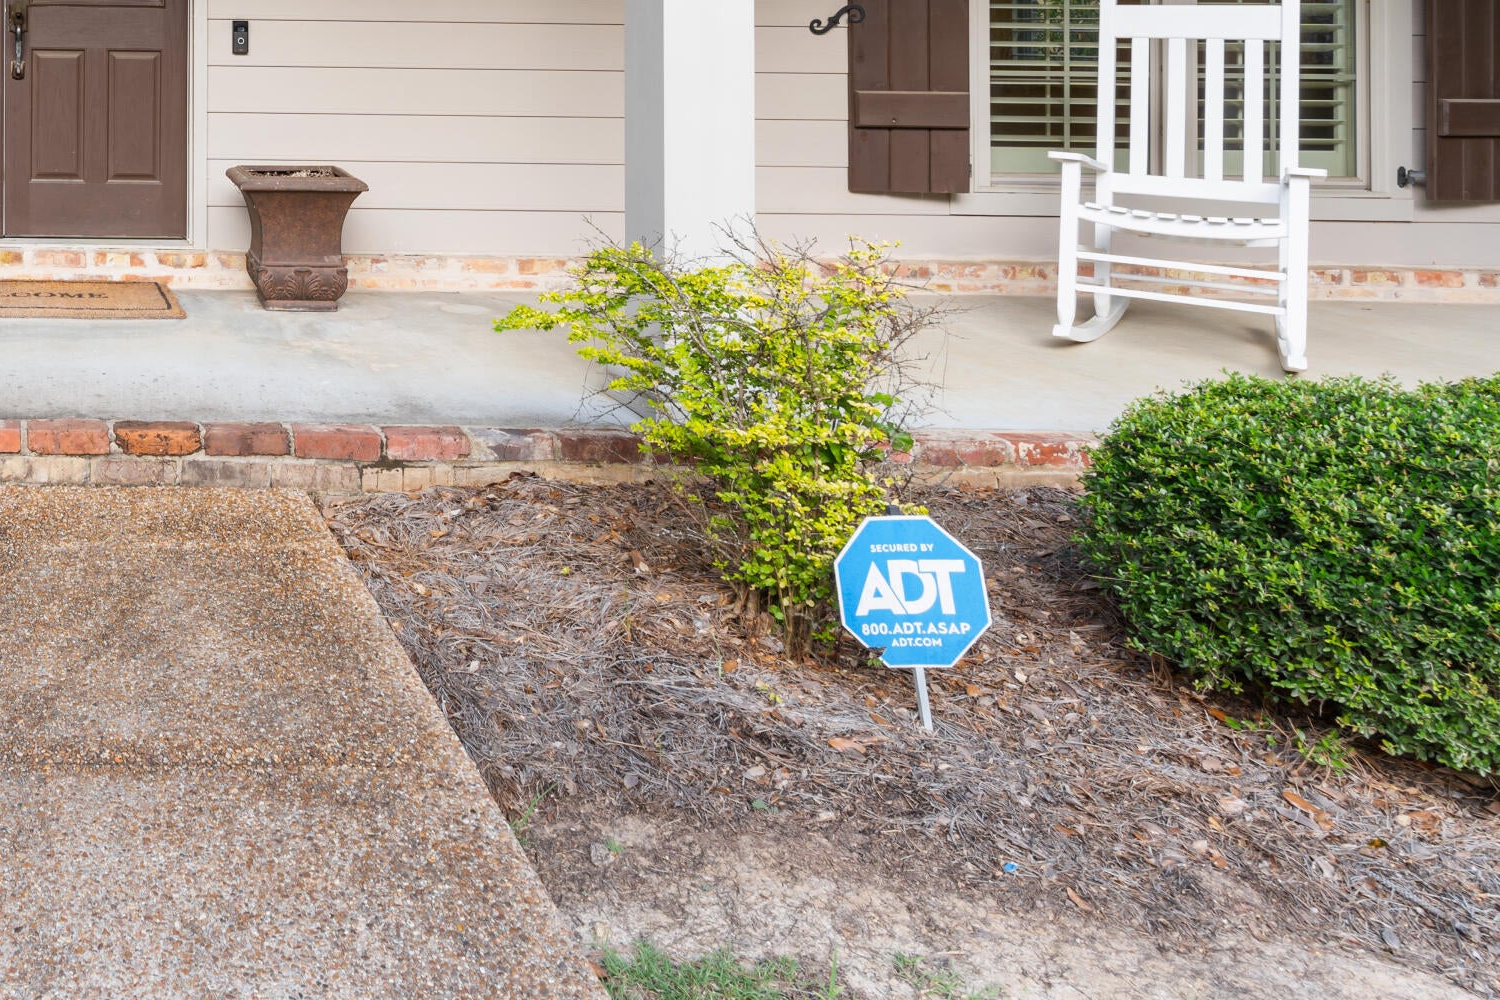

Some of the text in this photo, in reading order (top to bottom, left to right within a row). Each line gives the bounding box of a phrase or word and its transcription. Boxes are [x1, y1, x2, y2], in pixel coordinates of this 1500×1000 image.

[870, 543, 934, 553] SECURED BY
[855, 559, 966, 616] ADT
[861, 622, 971, 636] 800.ADT.ASAP
[891, 637, 943, 647] ADT.COM
